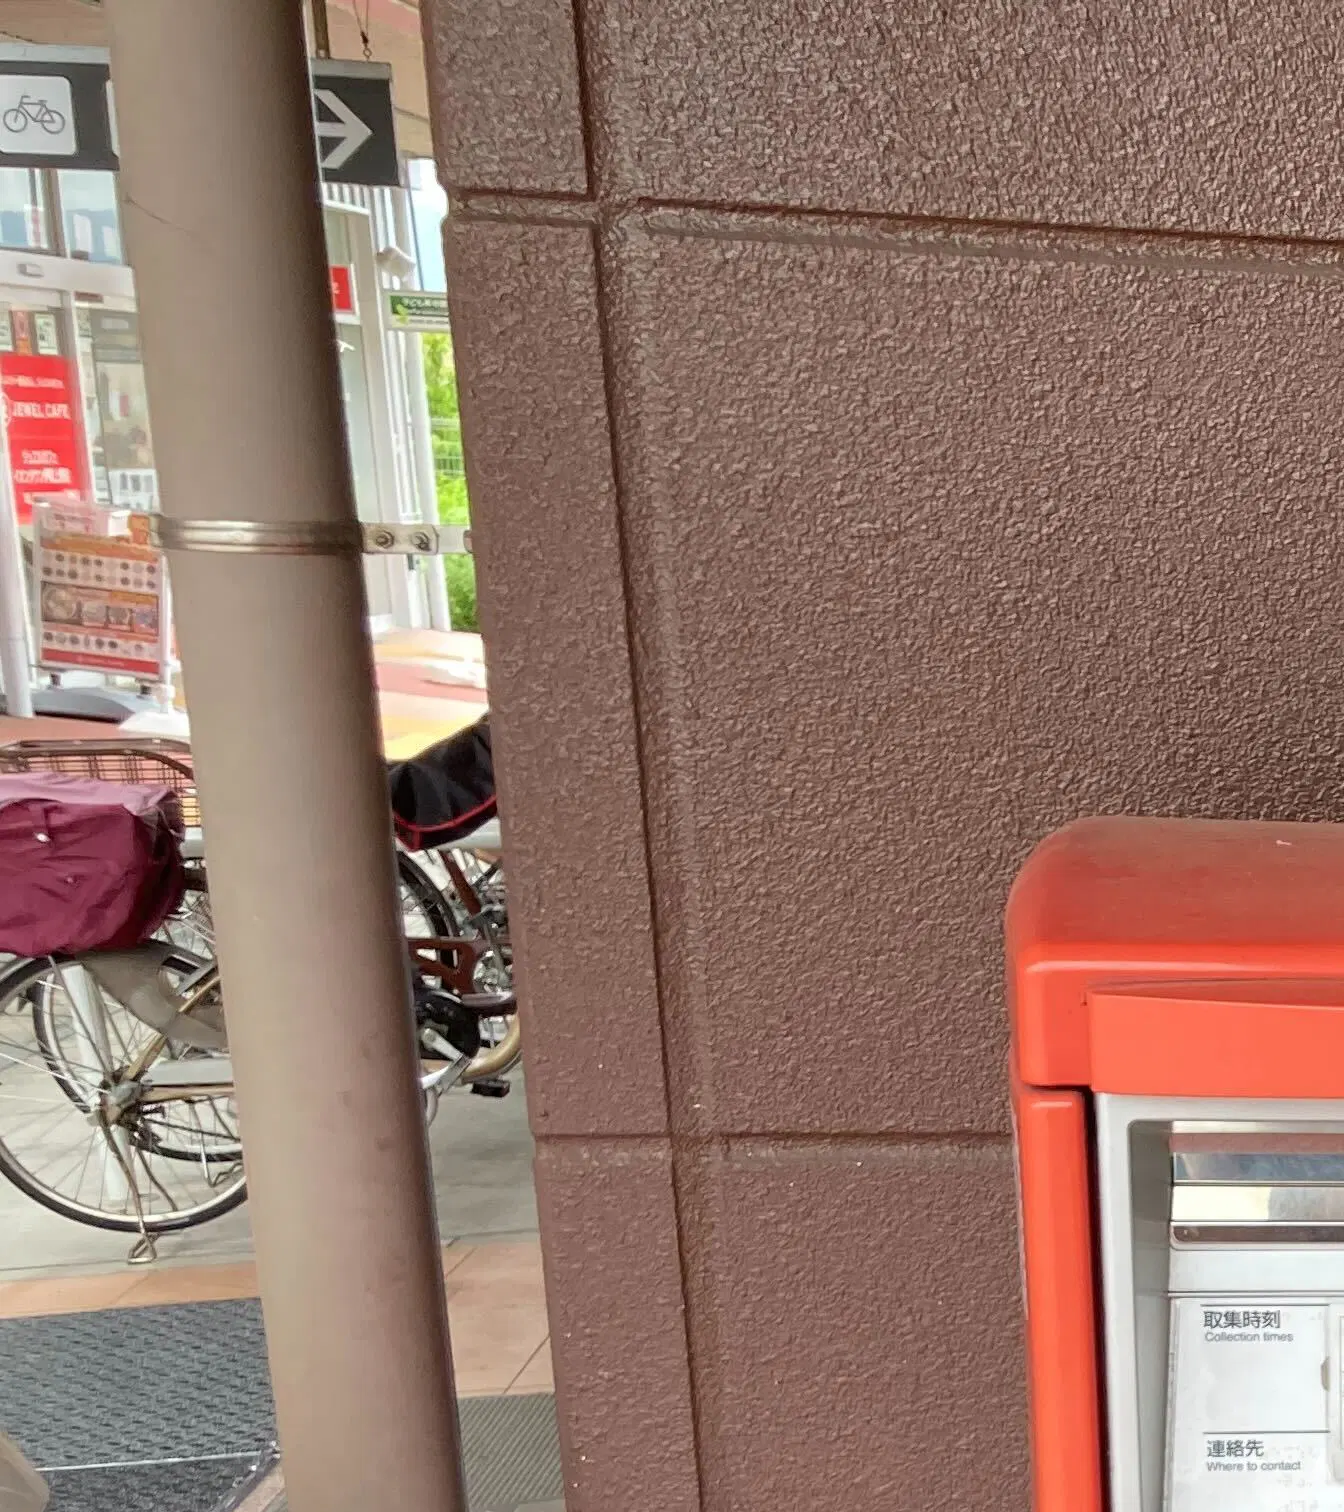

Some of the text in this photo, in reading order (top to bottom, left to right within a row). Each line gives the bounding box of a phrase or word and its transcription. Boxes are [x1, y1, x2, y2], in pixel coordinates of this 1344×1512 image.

[1203, 1310, 1281, 1329] 取集時刻
[1204, 1332, 1294, 1342] Collection times
[1207, 1439, 1265, 1457] 連絡先
[1206, 1461, 1301, 1472] Where to contact
